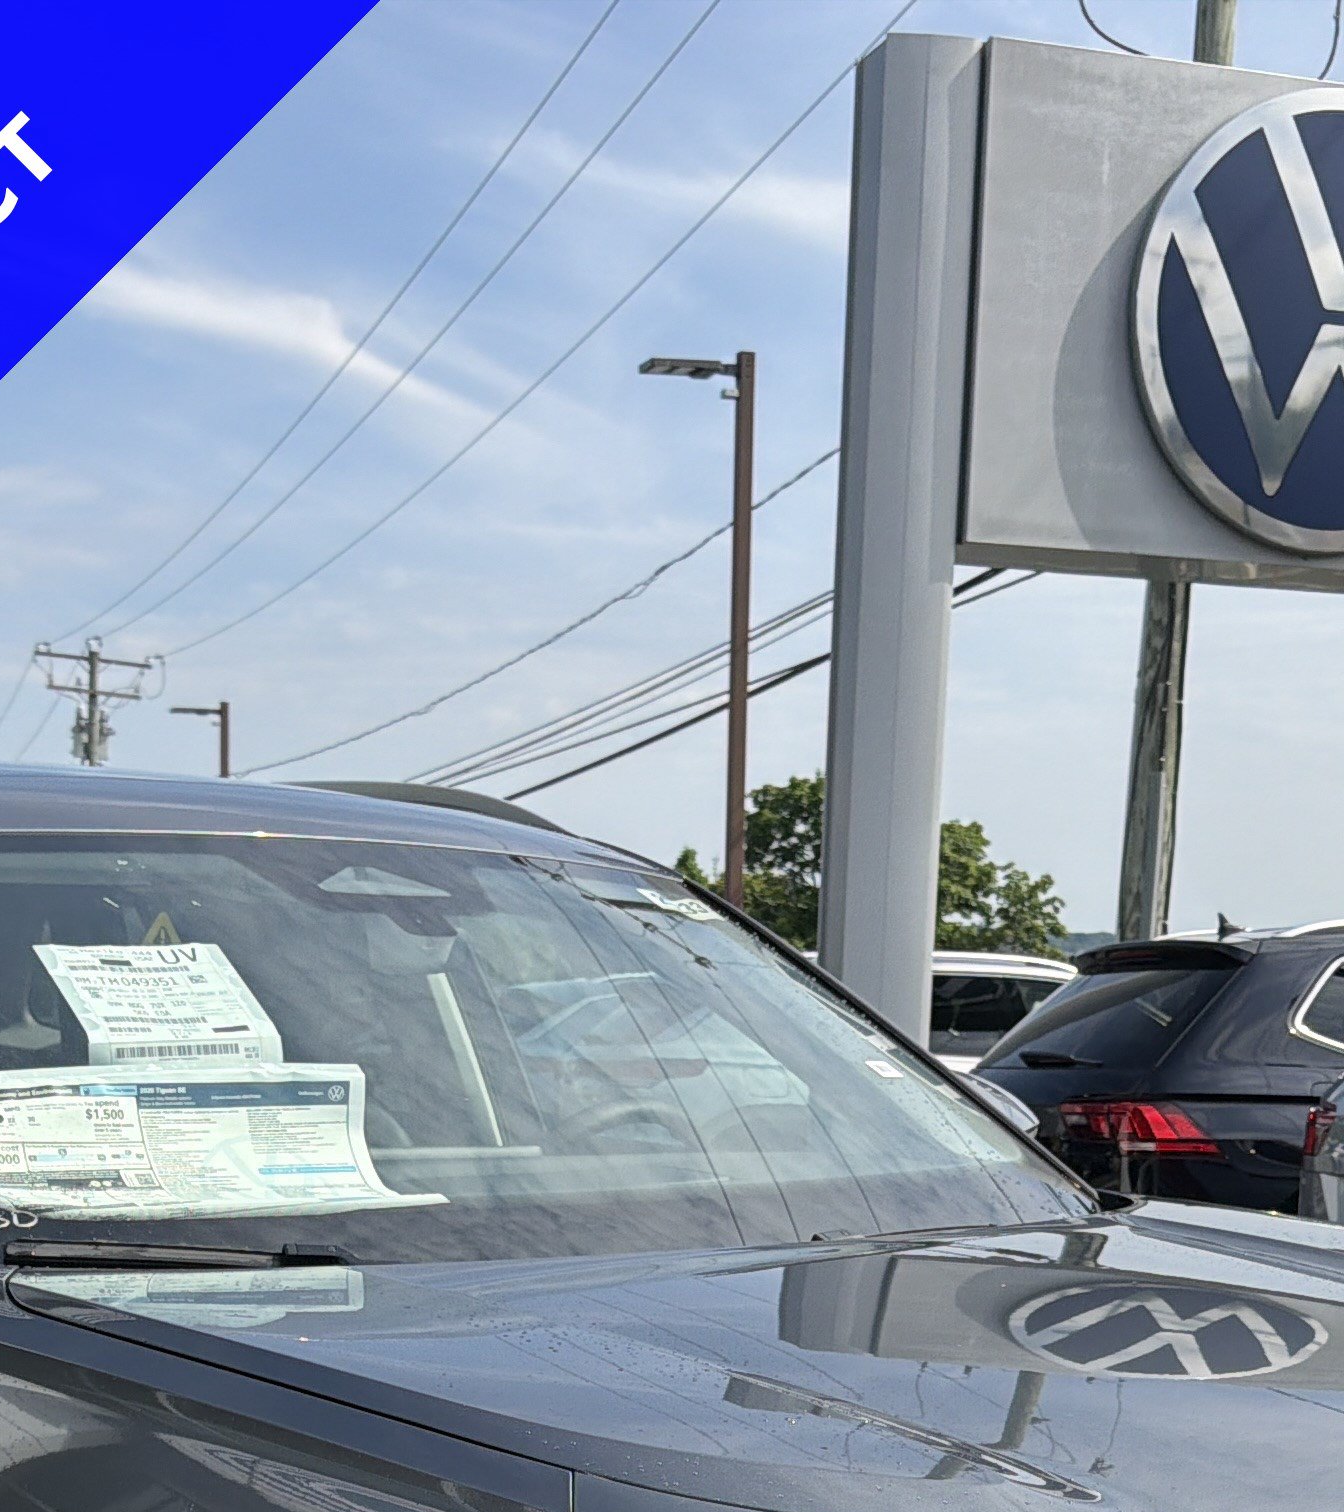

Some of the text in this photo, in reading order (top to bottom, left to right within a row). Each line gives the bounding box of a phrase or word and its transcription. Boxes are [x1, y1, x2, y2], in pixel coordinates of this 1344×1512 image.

[156, 947, 197, 965] UV
[94, 1099, 120, 1108] spend
[85, 1108, 125, 1121] $1,500
